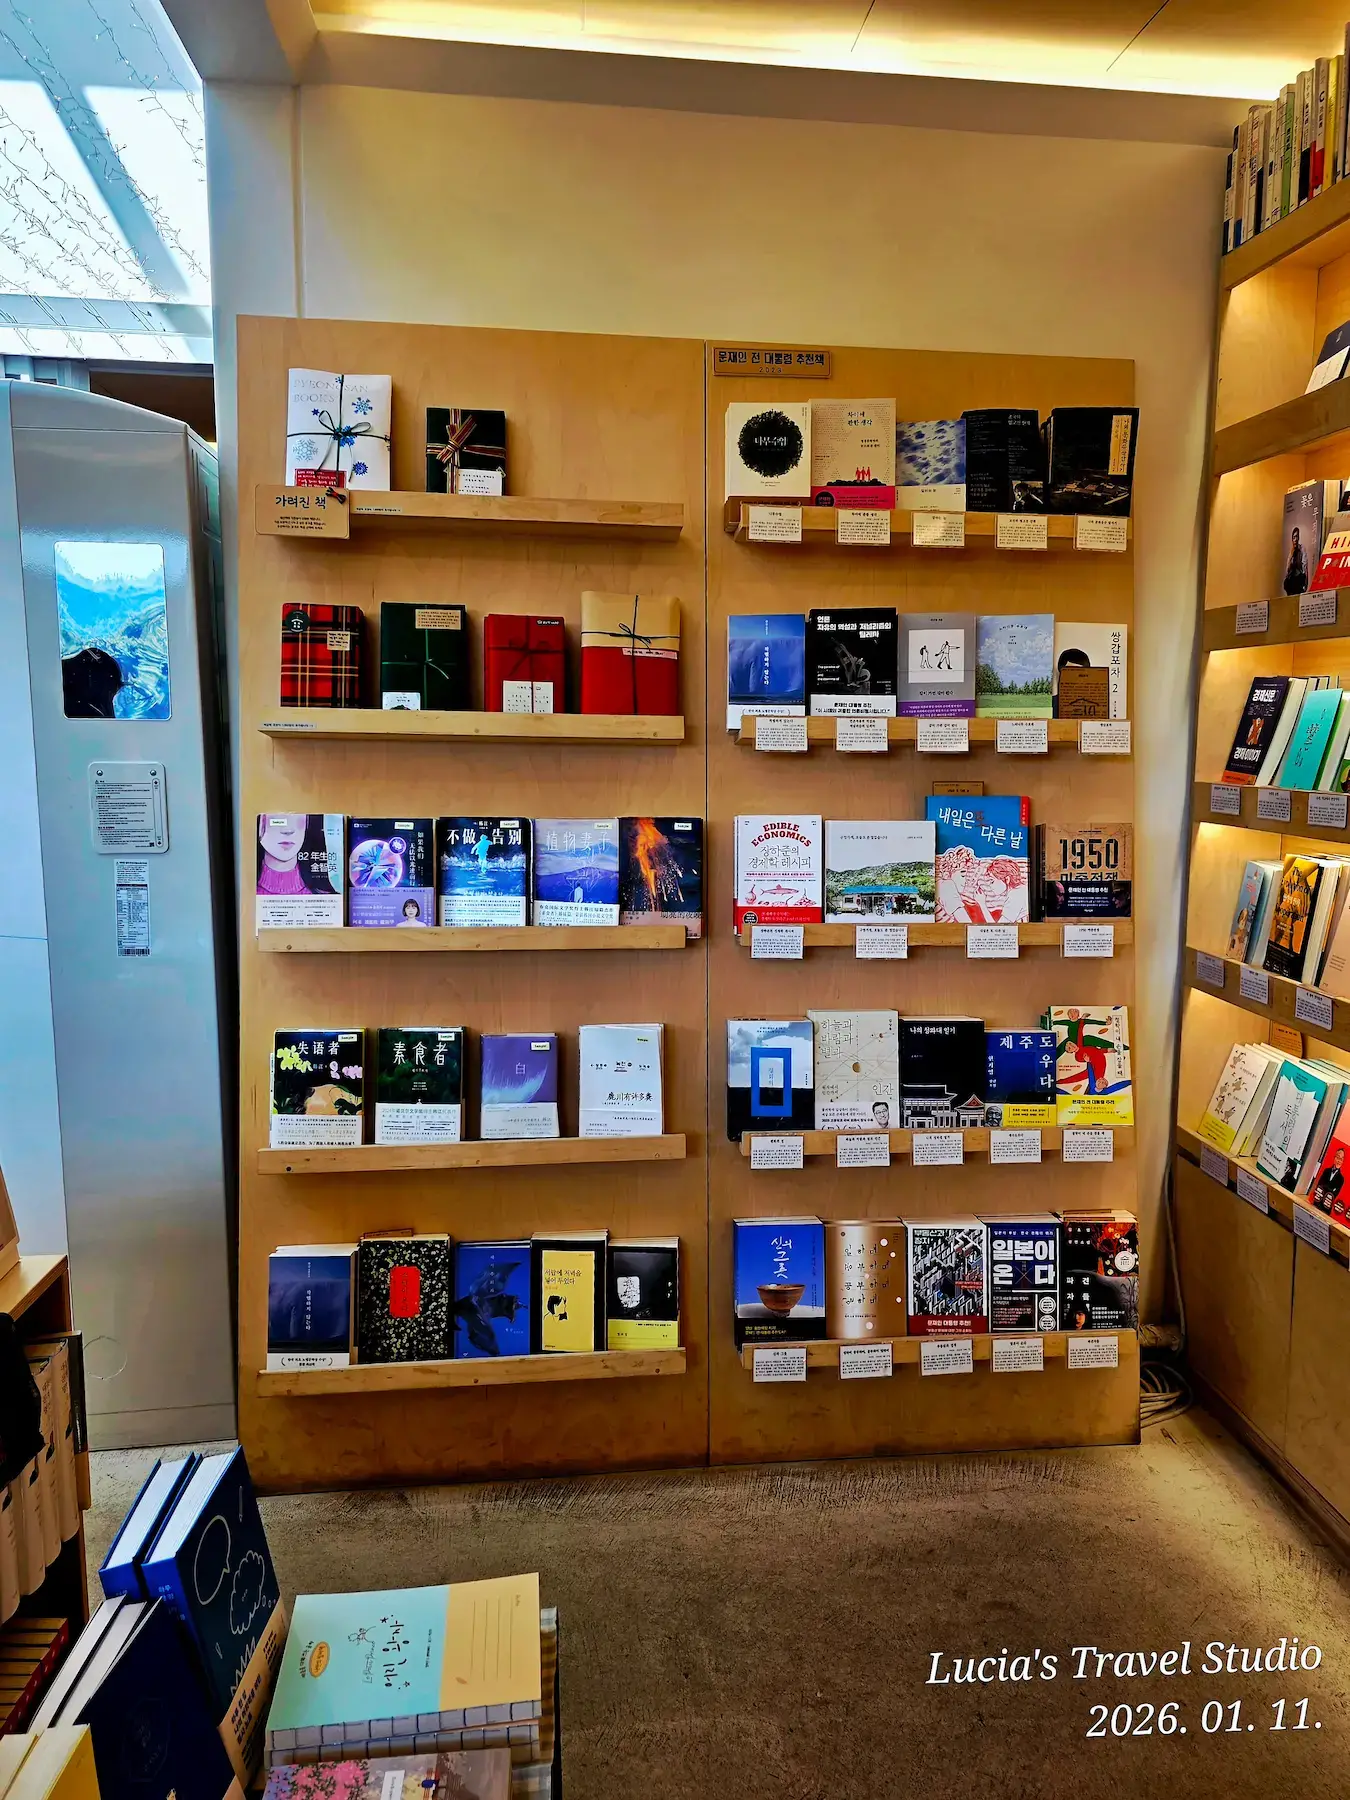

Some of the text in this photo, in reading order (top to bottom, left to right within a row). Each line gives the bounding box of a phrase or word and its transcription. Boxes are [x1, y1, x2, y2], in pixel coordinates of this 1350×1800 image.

[718, 351, 825, 366] 문재인 전 대통령 추천책
[754, 435, 789, 447] 나무수업
[275, 496, 327, 510] 가려진 책
[1330, 536, 1350, 550] HI
[816, 622, 892, 631] 자유의 역설과 저널리즘의
[817, 615, 830, 624] 언론
[859, 630, 880, 639] 딜레마
[1110, 631, 1121, 678] 쌍갑포차
[1112, 683, 1118, 693] 2
[939, 807, 976, 829] 내일은
[762, 821, 800, 833] EDIBLE
[446, 828, 522, 845] 不做告别
[546, 831, 611, 851] 植物妻子
[750, 829, 812, 848] ECONOMICS
[981, 825, 1024, 850] 다른 날
[297, 851, 337, 861] 82 年生的
[760, 845, 800, 858] 장하준의
[1059, 838, 1119, 870] 1950
[310, 861, 338, 873] 金智英
[748, 856, 812, 869] 경제학 레시피
[821, 1018, 853, 1032] 하늘과
[909, 1026, 956, 1035] 나의 청와대 일기
[821, 1032, 854, 1046] 바람과
[999, 1034, 1054, 1050] 제주도
[297, 1040, 341, 1056] 失语者
[393, 1040, 449, 1066] 素食者
[821, 1047, 842, 1059] 별과
[515, 1062, 526, 1075] 白
[1039, 1055, 1054, 1089] 우다
[872, 1082, 894, 1096] 인간
[913, 1229, 945, 1237] 부동산과
[770, 1236, 793, 1250] 신의
[992, 1239, 1055, 1261] 일본이
[773, 1251, 790, 1279] 그릇
[544, 1269, 582, 1277] 서랍에 저녁을
[992, 1263, 1056, 1285] 온다
[557, 1277, 575, 1285] 두었다
[1066, 1276, 1090, 1285] 파견
[1066, 1292, 1090, 1301] 자들
[382, 1620, 410, 1688] 어린 왕자
